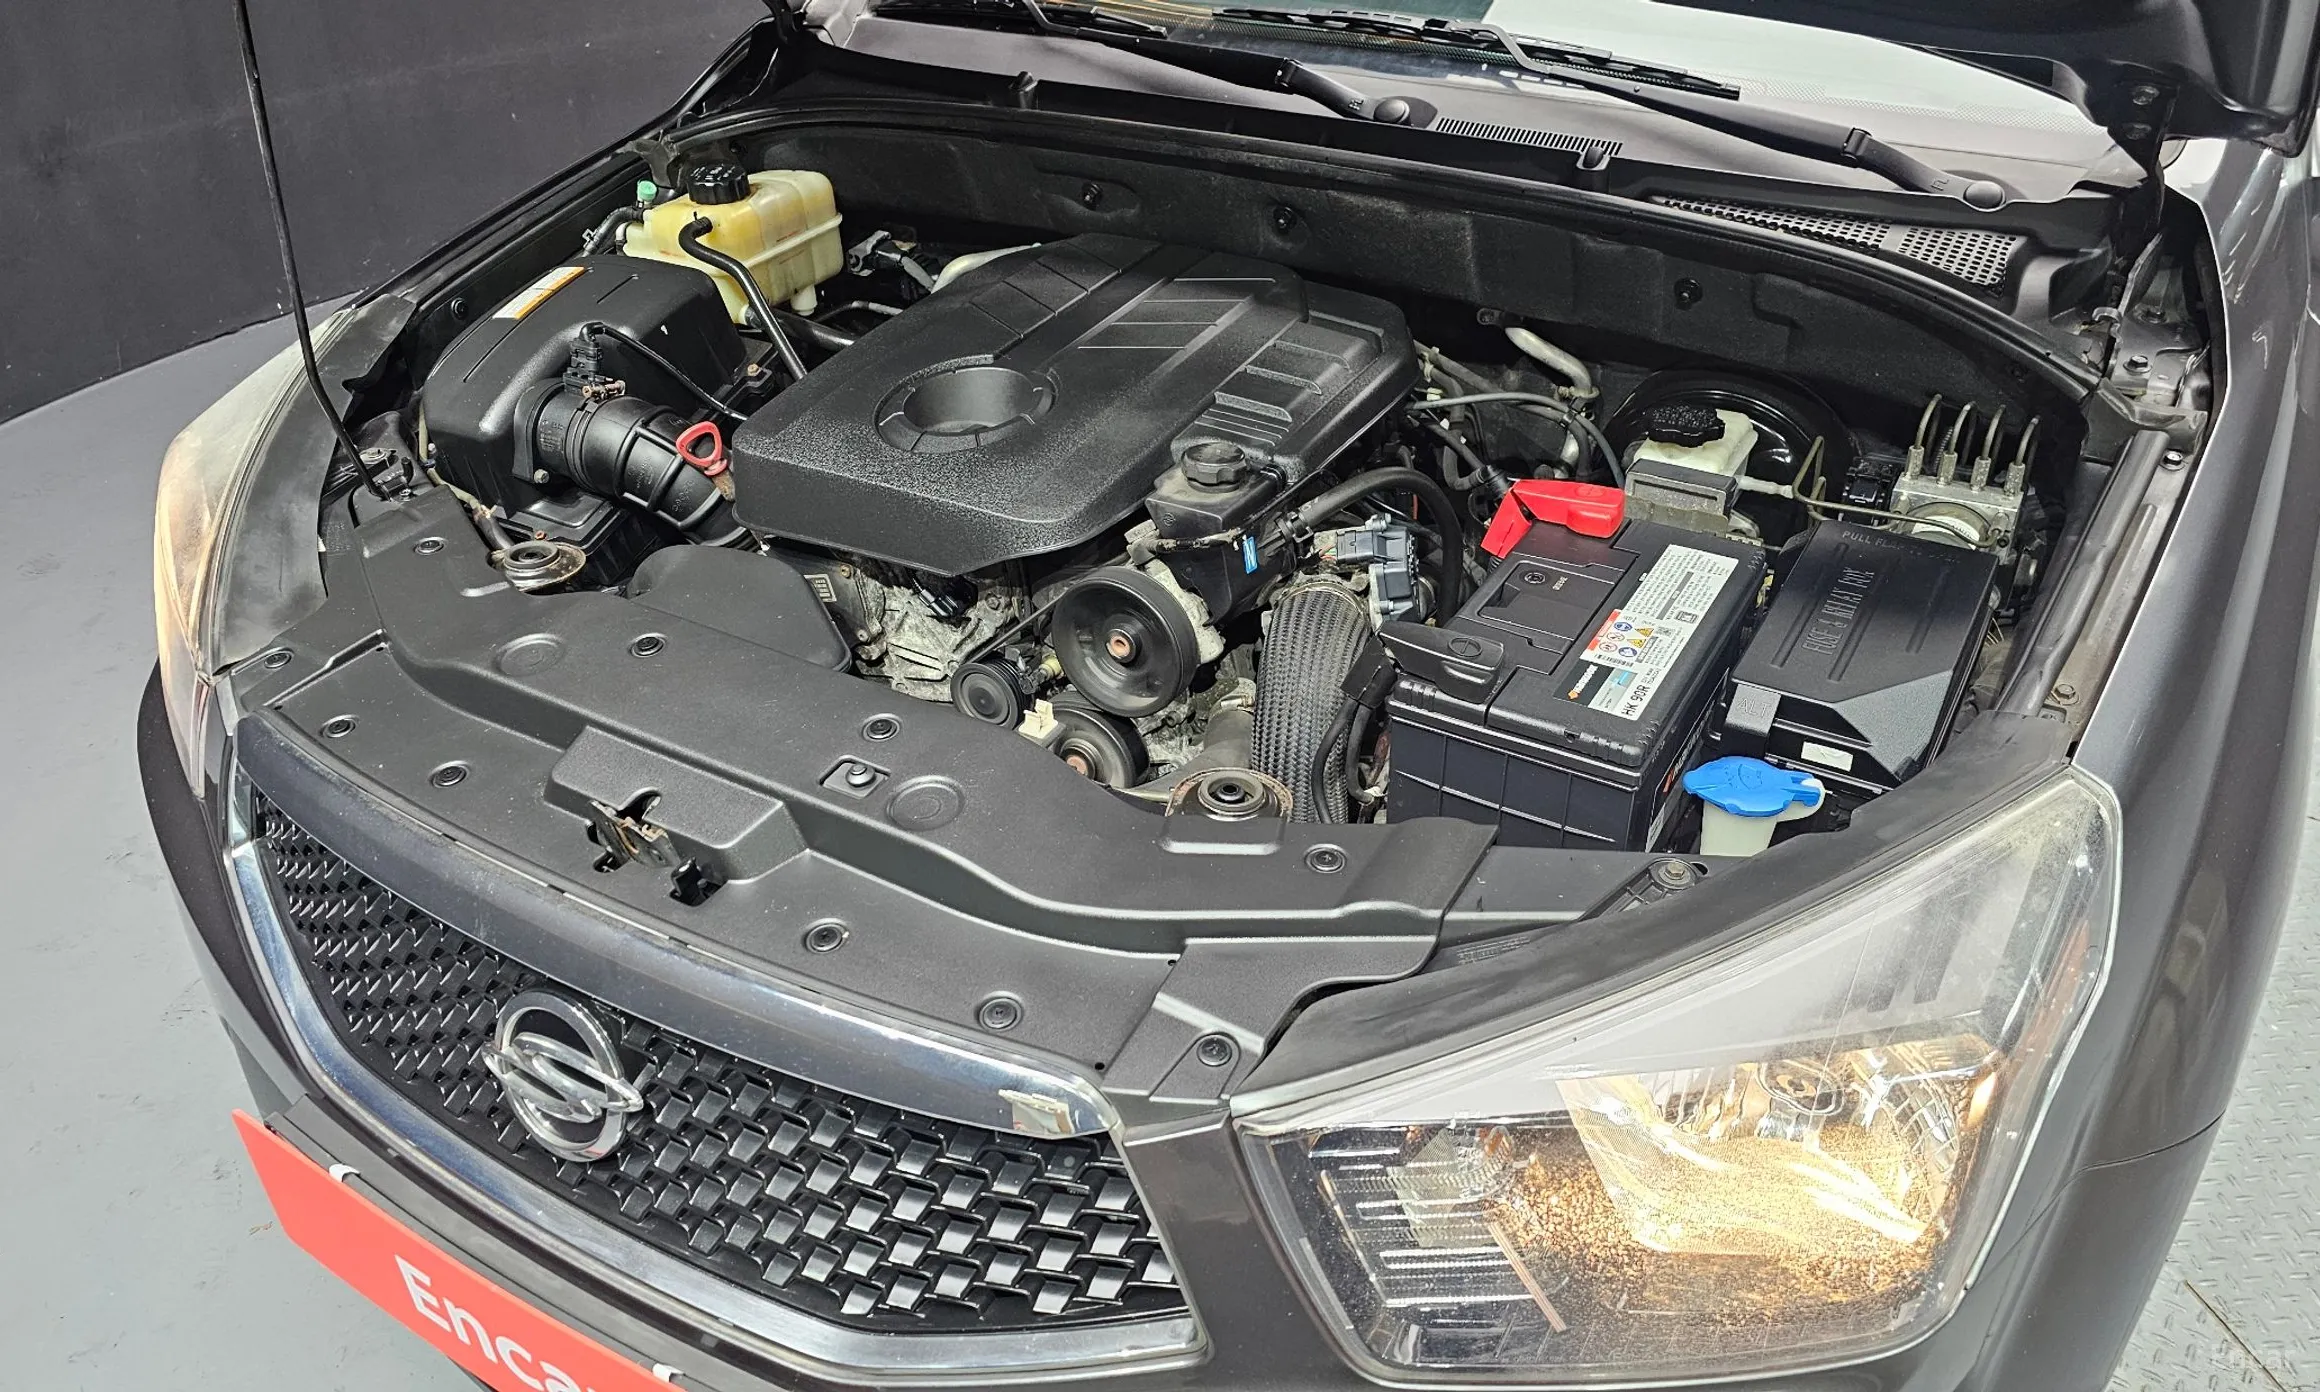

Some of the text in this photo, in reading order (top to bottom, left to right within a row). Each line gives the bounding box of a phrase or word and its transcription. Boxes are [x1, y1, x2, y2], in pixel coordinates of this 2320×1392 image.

[1842, 530, 1871, 545] PULL
[1821, 587, 1863, 619] RELAY
[1802, 627, 1843, 655] FUSE
[1621, 684, 1650, 716] HK 90R
[1736, 698, 1771, 718] ALT
[394, 1254, 598, 1392] Enca
